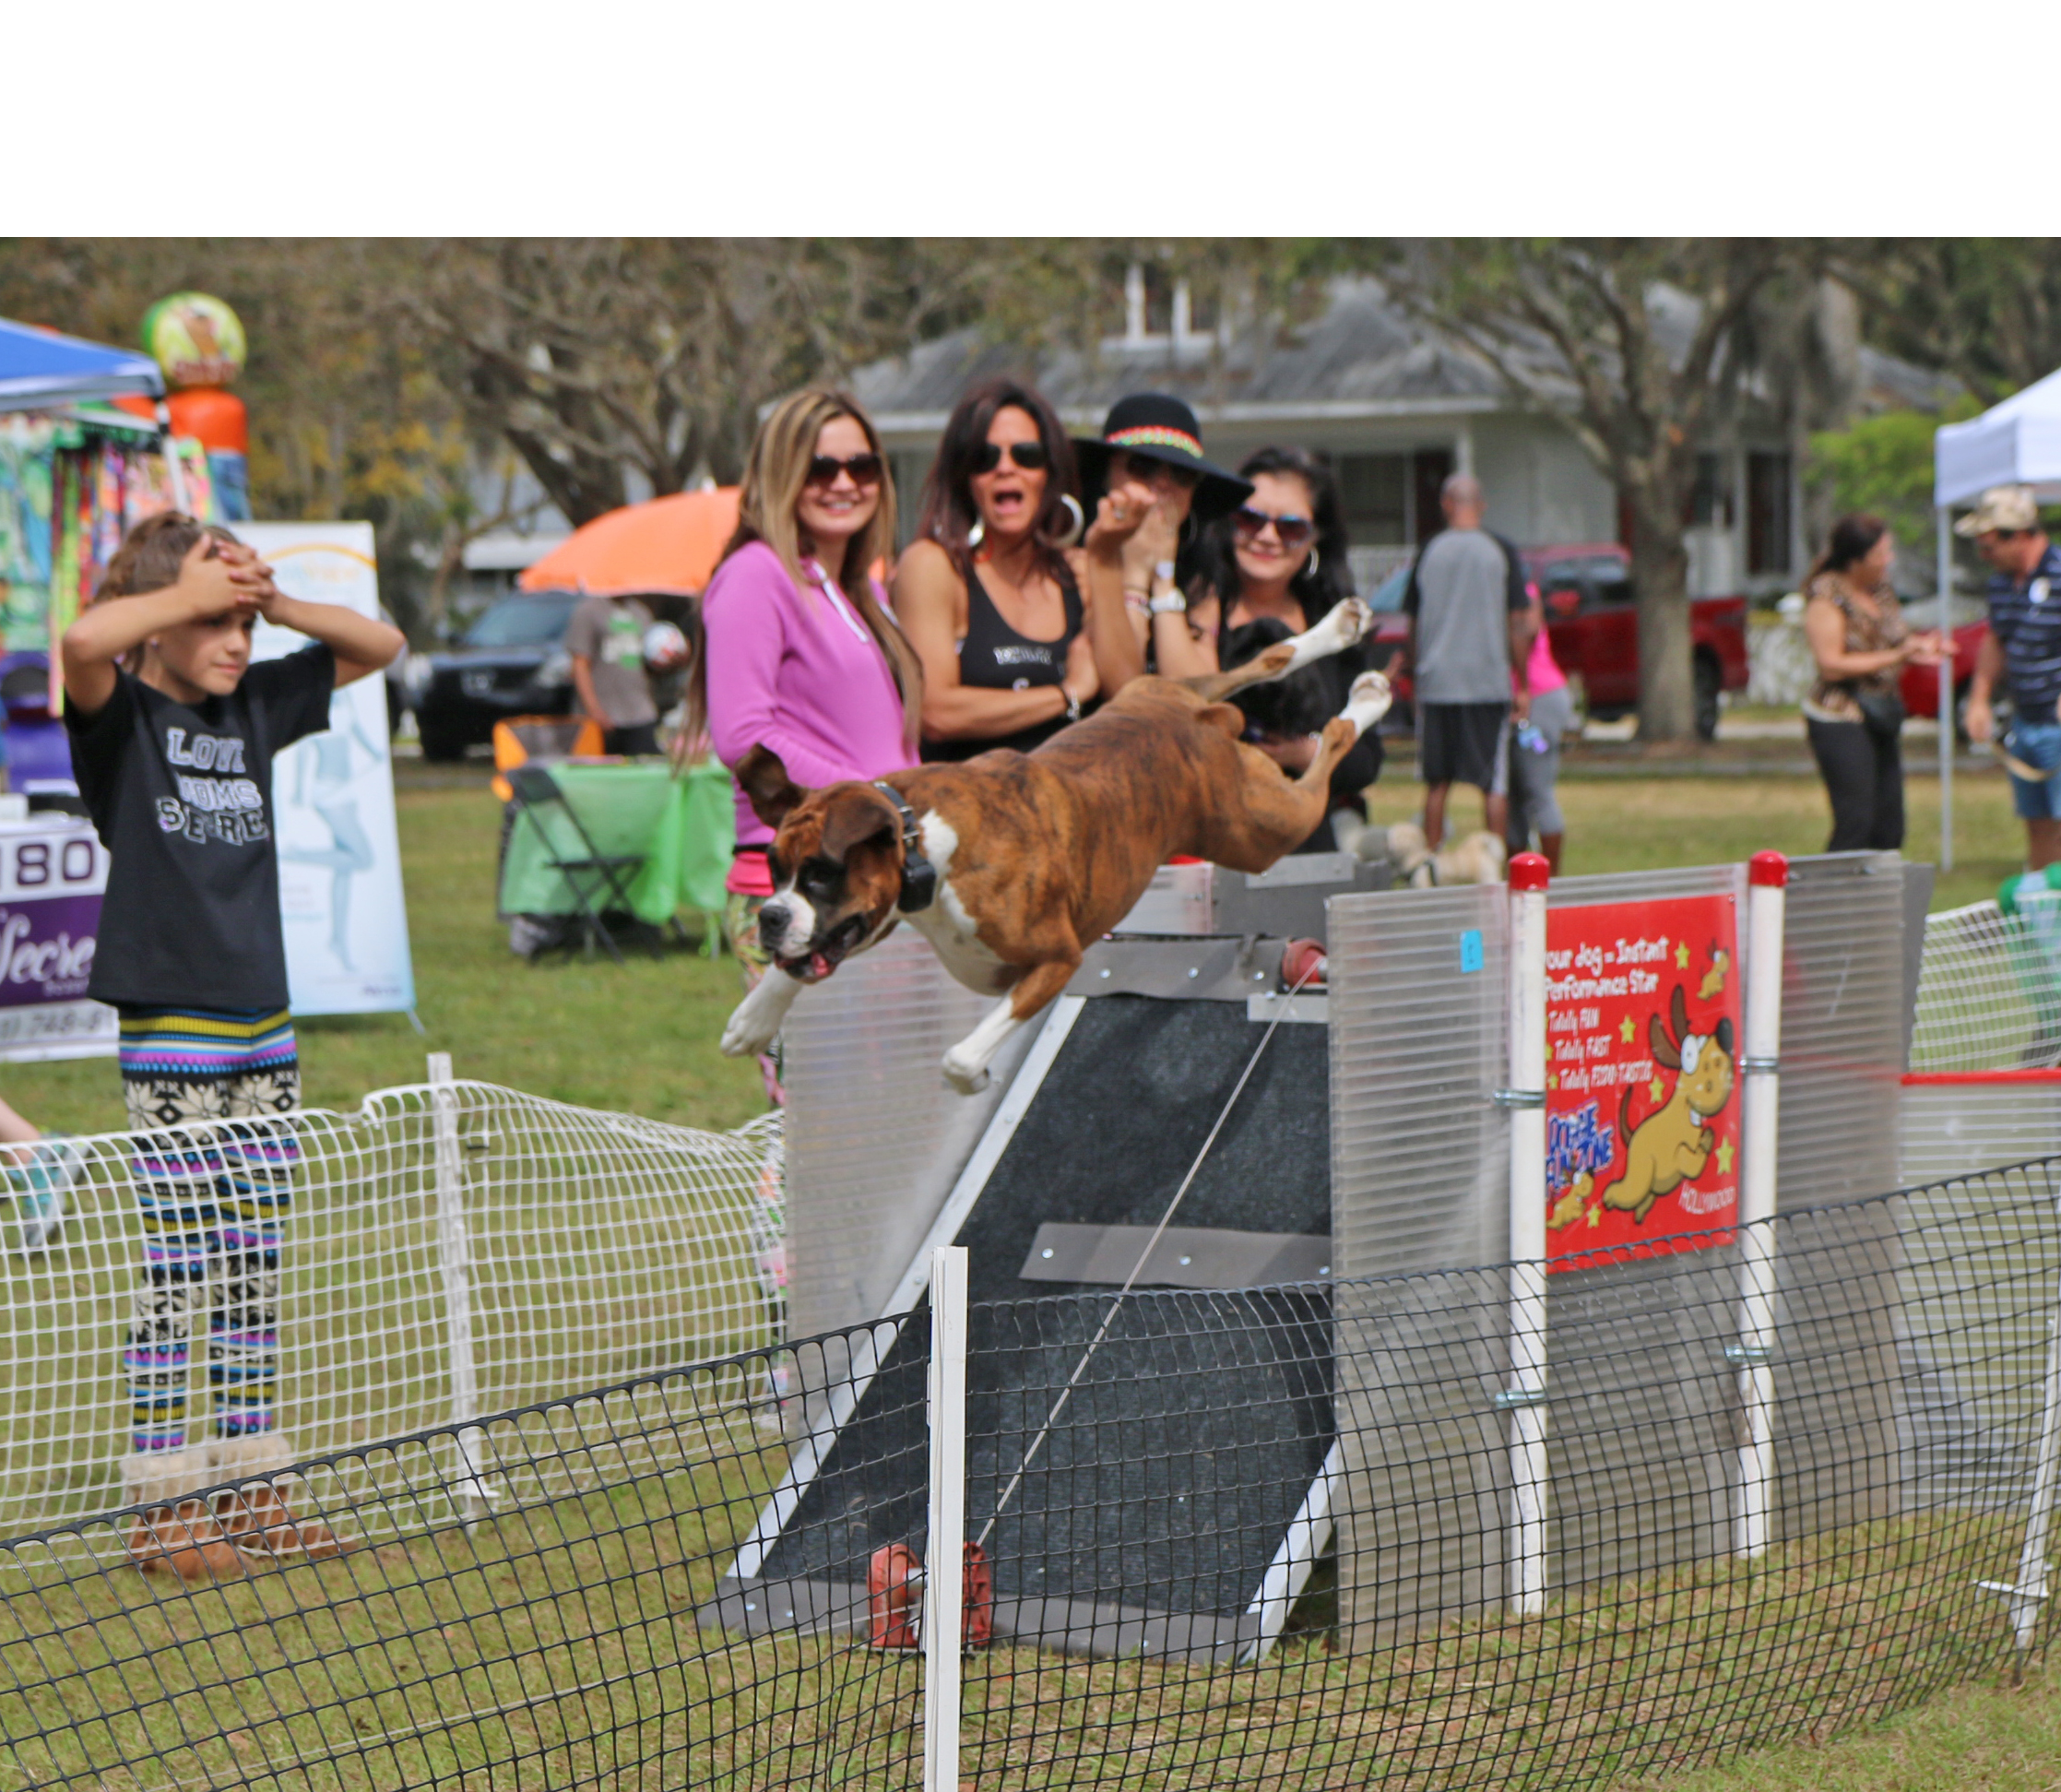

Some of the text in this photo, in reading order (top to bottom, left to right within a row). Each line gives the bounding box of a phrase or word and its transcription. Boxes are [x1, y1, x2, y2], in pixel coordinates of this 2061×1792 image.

[0, 838, 94, 886] 80
[1546, 948, 1573, 970] our
[1574, 941, 1604, 977] dog
[1616, 935, 1670, 965] Instant
[1629, 967, 1659, 994] Star
[1548, 1006, 1601, 1037] Totally FUN
[1555, 1034, 1613, 1065] Totally FAST
[1559, 1066, 1590, 1095] Totally
